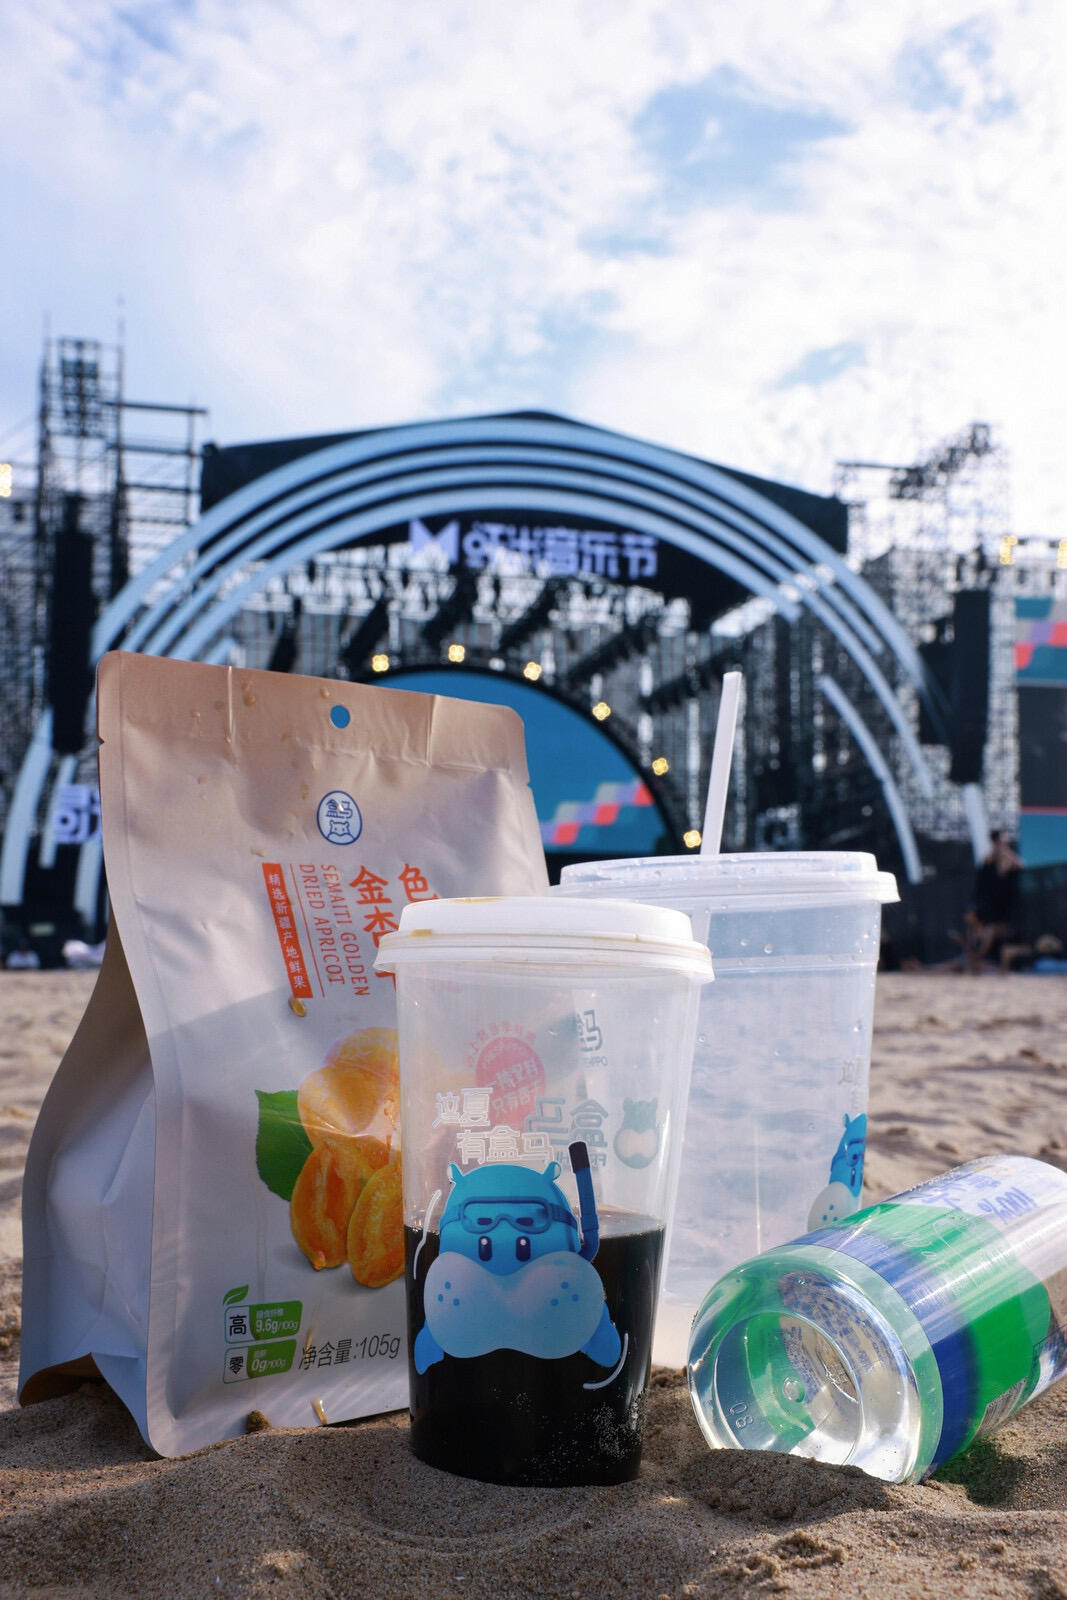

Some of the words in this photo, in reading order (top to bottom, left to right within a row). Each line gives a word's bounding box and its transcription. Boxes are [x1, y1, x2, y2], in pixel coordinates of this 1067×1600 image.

[299, 864, 326, 910] DRIED
[314, 916, 346, 985] APRICOT
[339, 932, 371, 996] GOLDEN
[456, 1125, 554, 1165] 有盒马
[229, 1314, 248, 1337] 高
[229, 1355, 244, 1375] 零
